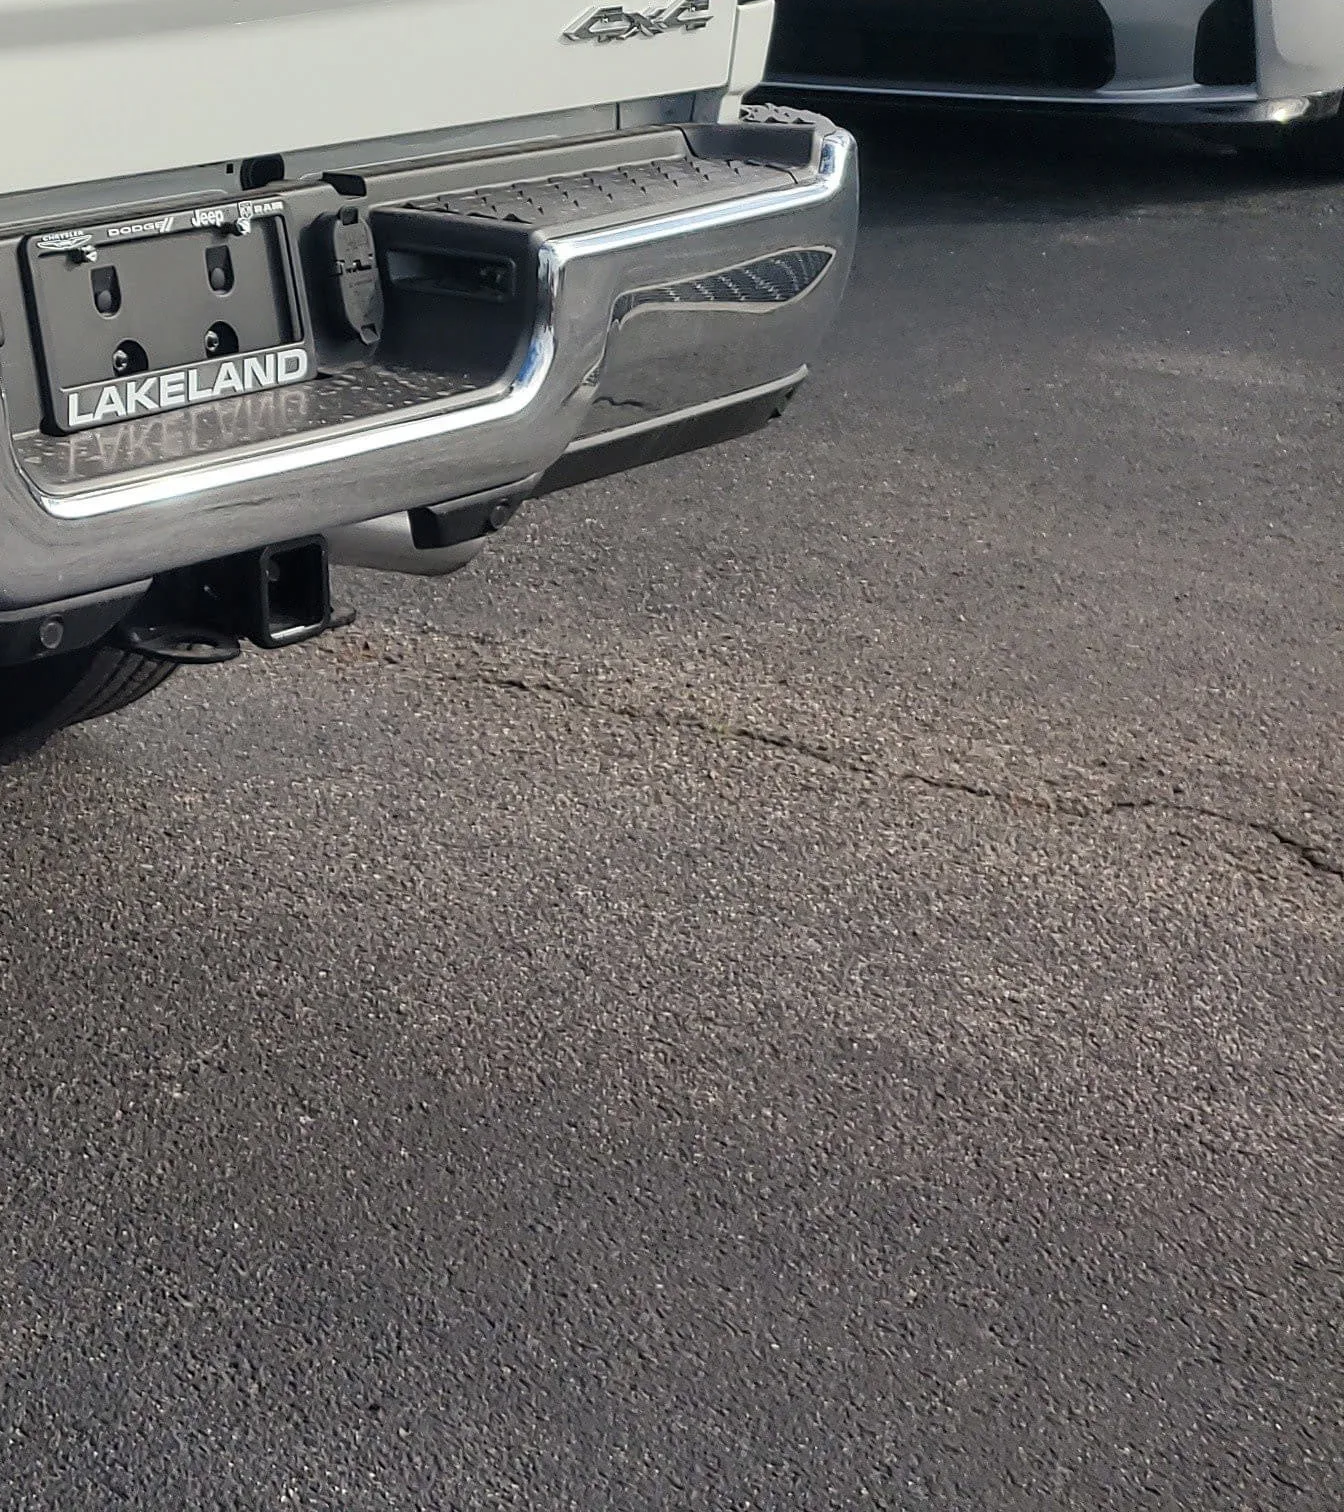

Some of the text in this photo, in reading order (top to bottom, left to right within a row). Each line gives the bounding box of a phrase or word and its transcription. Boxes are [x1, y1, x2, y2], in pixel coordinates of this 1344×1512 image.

[107, 220, 165, 237] DODGE
[191, 208, 224, 228] Jeep
[253, 201, 284, 214] RAM
[68, 348, 308, 427] LAKELAND
